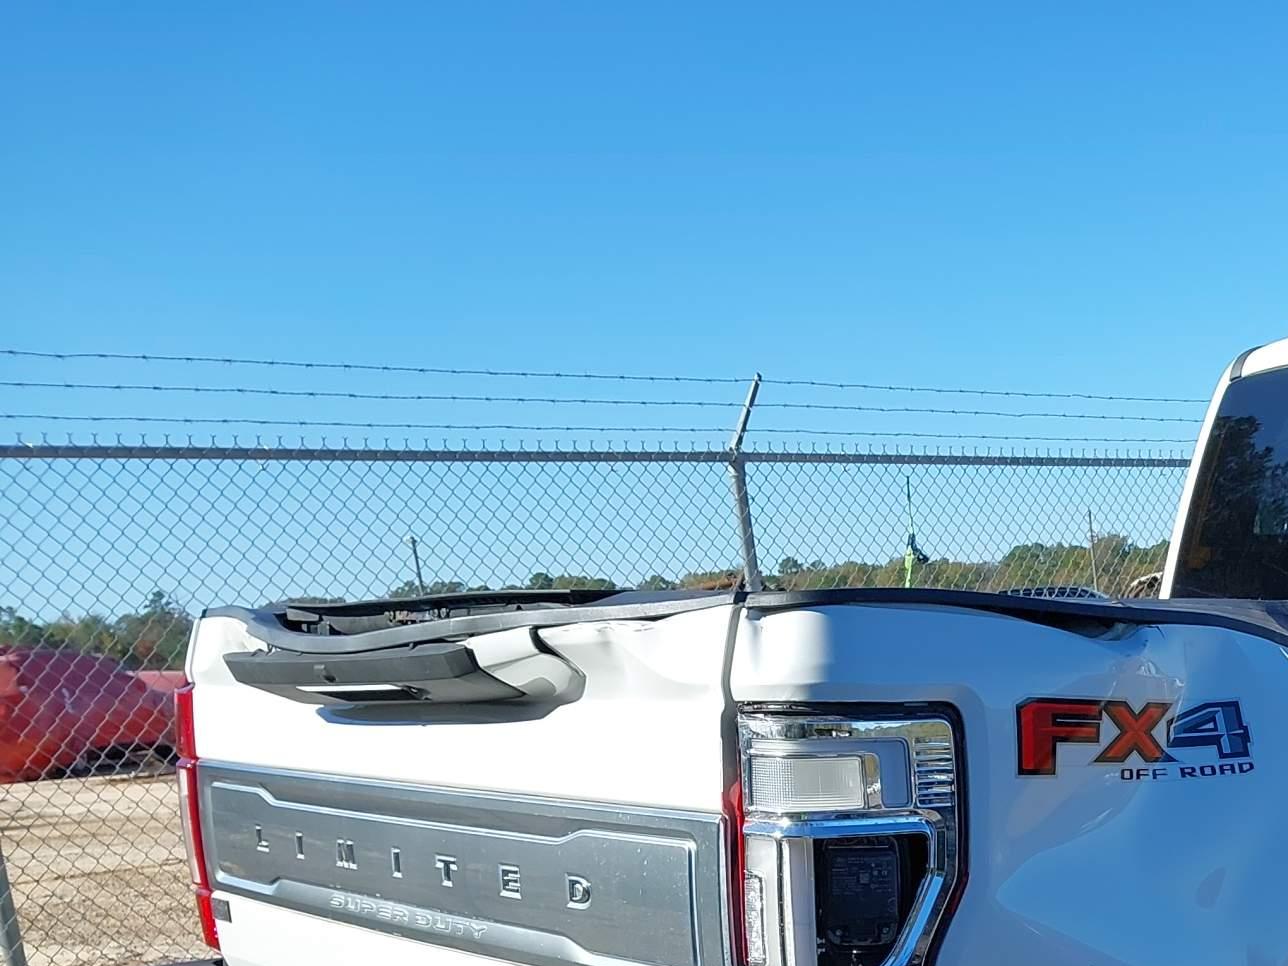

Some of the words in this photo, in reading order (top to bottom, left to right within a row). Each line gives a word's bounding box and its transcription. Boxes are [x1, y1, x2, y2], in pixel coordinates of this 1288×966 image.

[1016, 697, 1253, 777] FX4
[1120, 768, 1169, 781] OFF
[1180, 761, 1254, 779] ROAD
[255, 824, 592, 910] LIMITED
[328, 894, 410, 923] SUPER
[415, 912, 489, 940] DUTY
